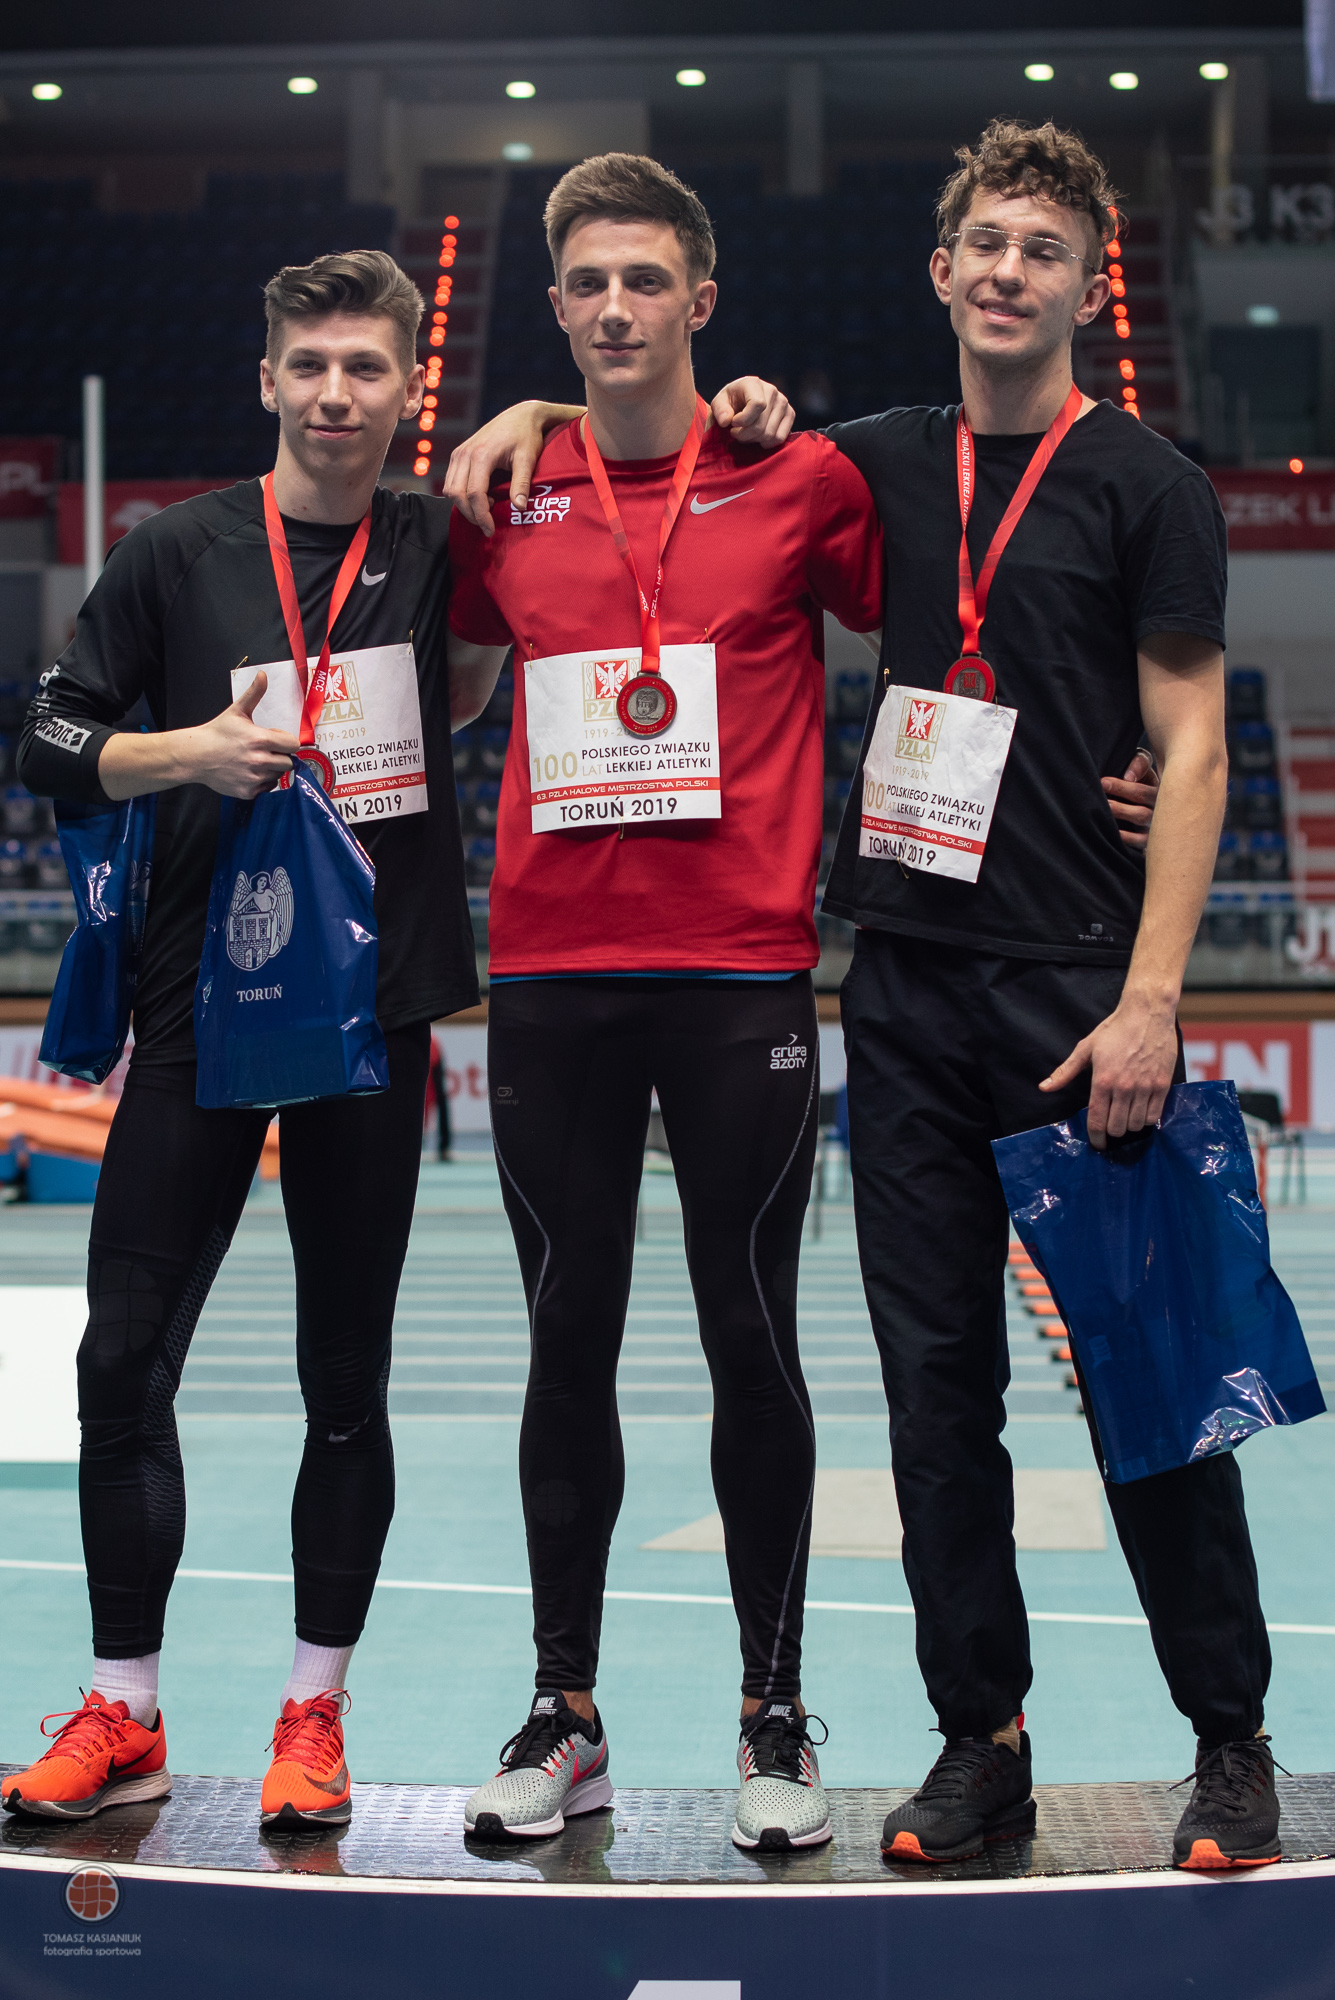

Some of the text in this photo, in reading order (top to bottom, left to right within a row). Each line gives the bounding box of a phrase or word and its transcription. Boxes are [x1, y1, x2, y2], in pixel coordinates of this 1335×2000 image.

[962, 468, 971, 498] LEKKIEJ
[315, 670, 327, 692] MCC
[322, 703, 361, 722] ZLA
[586, 701, 618, 719] PZ
[316, 727, 366, 743] 919-2019
[328, 738, 420, 762] LSKIEGO ZWIĄZKU
[582, 741, 710, 760] POLSKIEGO ZWIĄZKU
[897, 738, 931, 760] PZLA
[336, 753, 421, 776] LEKKIEJ ATLETYKI
[533, 751, 711, 783] 100 LAT LEKKIEJ ATLETYKI
[340, 780, 398, 794] MISTRZOSTWA
[398, 775, 421, 785] POLSKI
[549, 790, 569, 799] PZLA
[569, 785, 606, 796] HALOWE
[607, 781, 674, 792] MISTRZOSTWA
[675, 780, 709, 788] POLSKI
[363, 794, 402, 816] 2019
[560, 796, 678, 822] TORUŃ 2019
[863, 779, 981, 832] 100 LAT LEKKIEJ ATLETYKI
[886, 784, 985, 816] POLSKIEGO ZWIĄZKU
[869, 836, 937, 867] TORUŃ 2019
[939, 833, 973, 849] POLSKI
[236, 983, 283, 1002] TORUŃ
[535, 1696, 556, 1709] NIKE
[768, 1704, 792, 1716] NIKE
